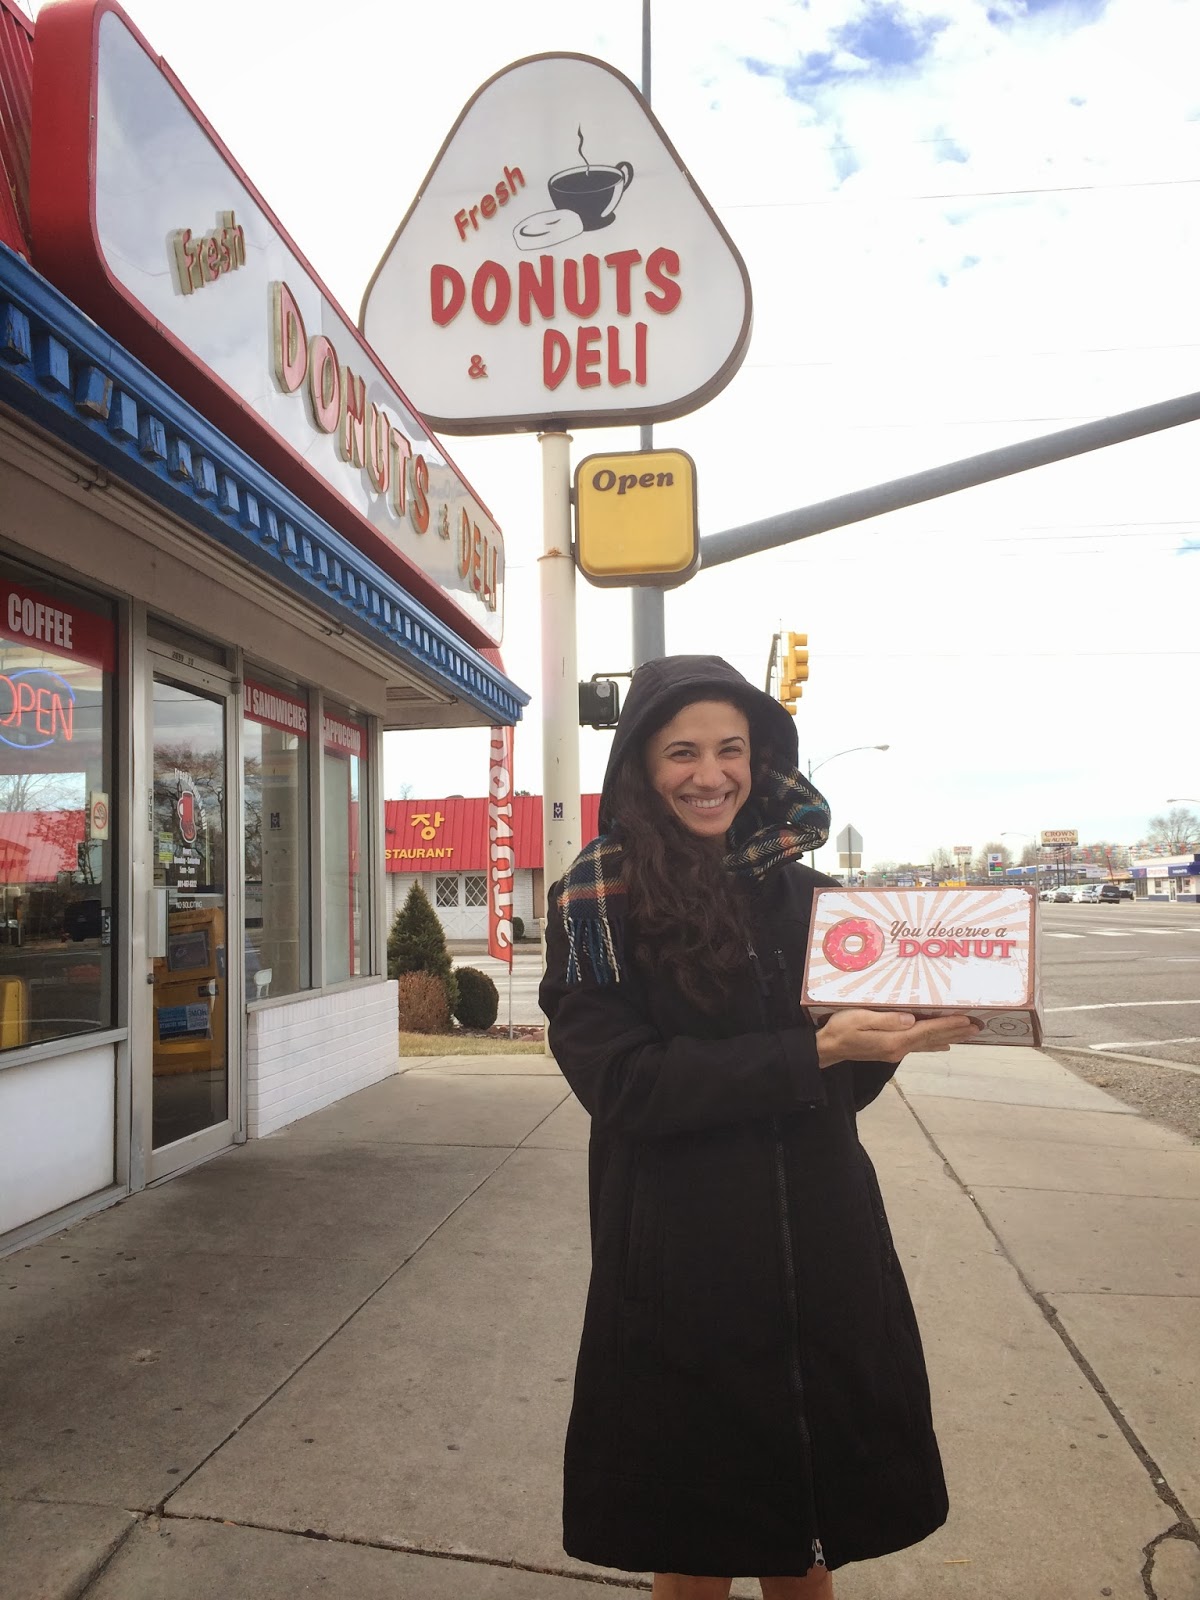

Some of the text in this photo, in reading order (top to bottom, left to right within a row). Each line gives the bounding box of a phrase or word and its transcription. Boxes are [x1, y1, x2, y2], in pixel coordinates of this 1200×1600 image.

[453, 165, 525, 242] Fresh
[173, 210, 246, 295] Fresh
[430, 247, 682, 326] DONUTS
[468, 321, 648, 390] & DELI
[272, 281, 430, 534] DONUTS
[458, 506, 497, 612] DELI
[592, 468, 674, 495] Open
[8, 592, 73, 650] COFFEE
[252, 688, 307, 733] SANDWICHES
[411, 811, 445, 841] 장
[890, 920, 1008, 943] You deserve a
[897, 938, 1016, 958] DONUT
